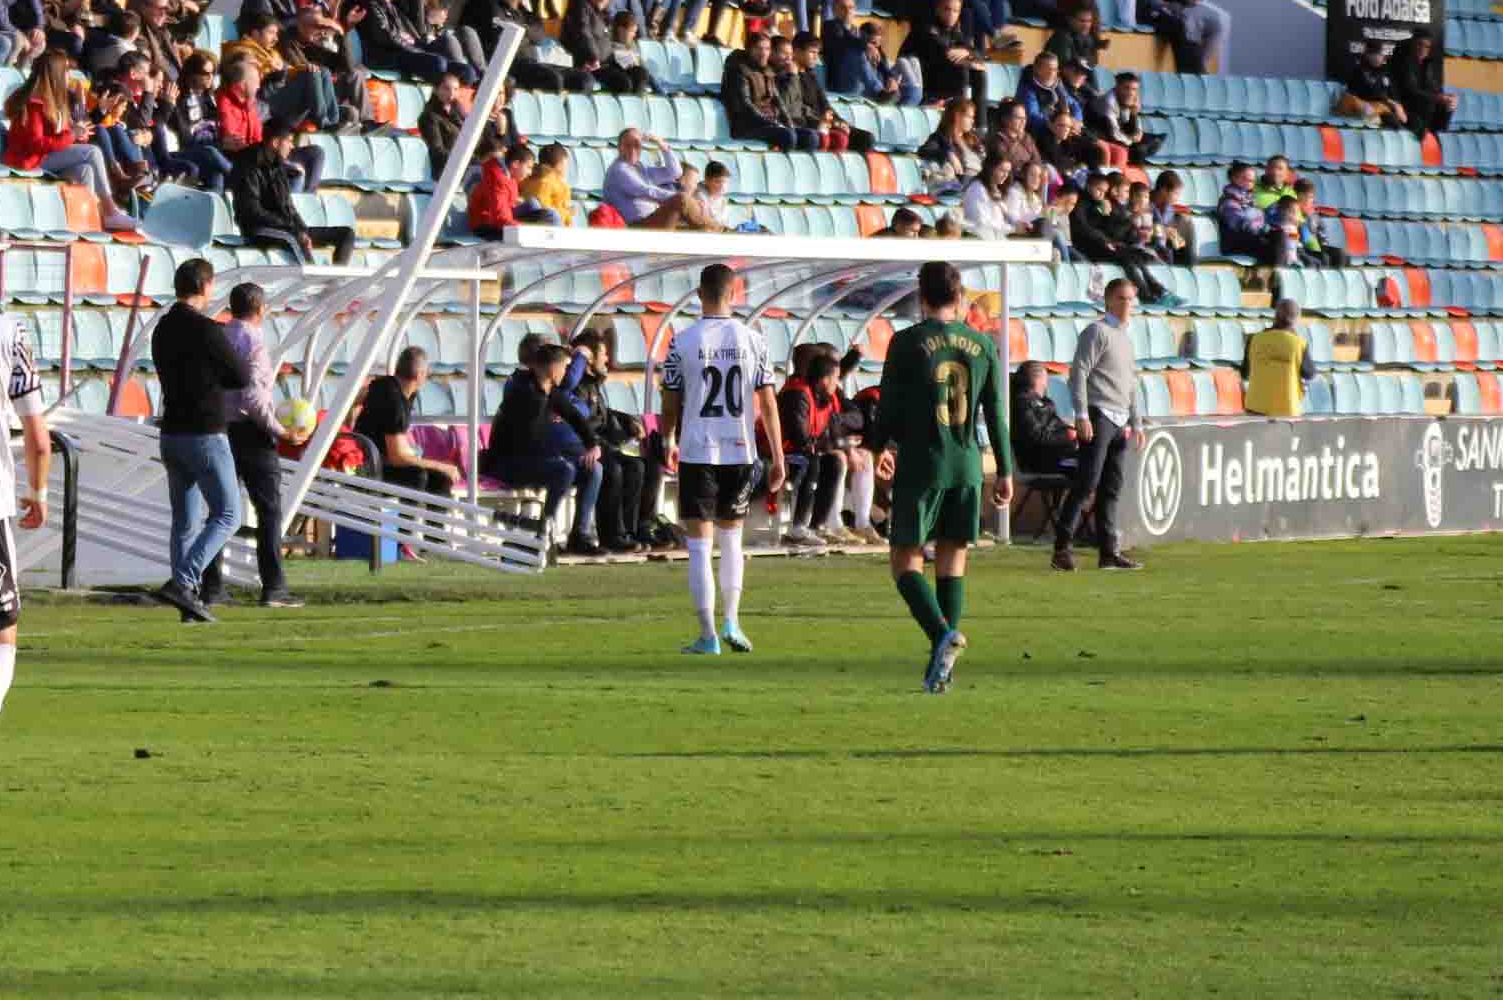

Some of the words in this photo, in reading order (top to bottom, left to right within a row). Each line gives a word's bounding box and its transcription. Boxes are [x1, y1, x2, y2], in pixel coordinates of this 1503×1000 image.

[699, 365, 744, 418] 20
[935, 360, 969, 426] 3
[1201, 435, 1380, 506] Helmántica
[1455, 425, 1503, 471] SAN
